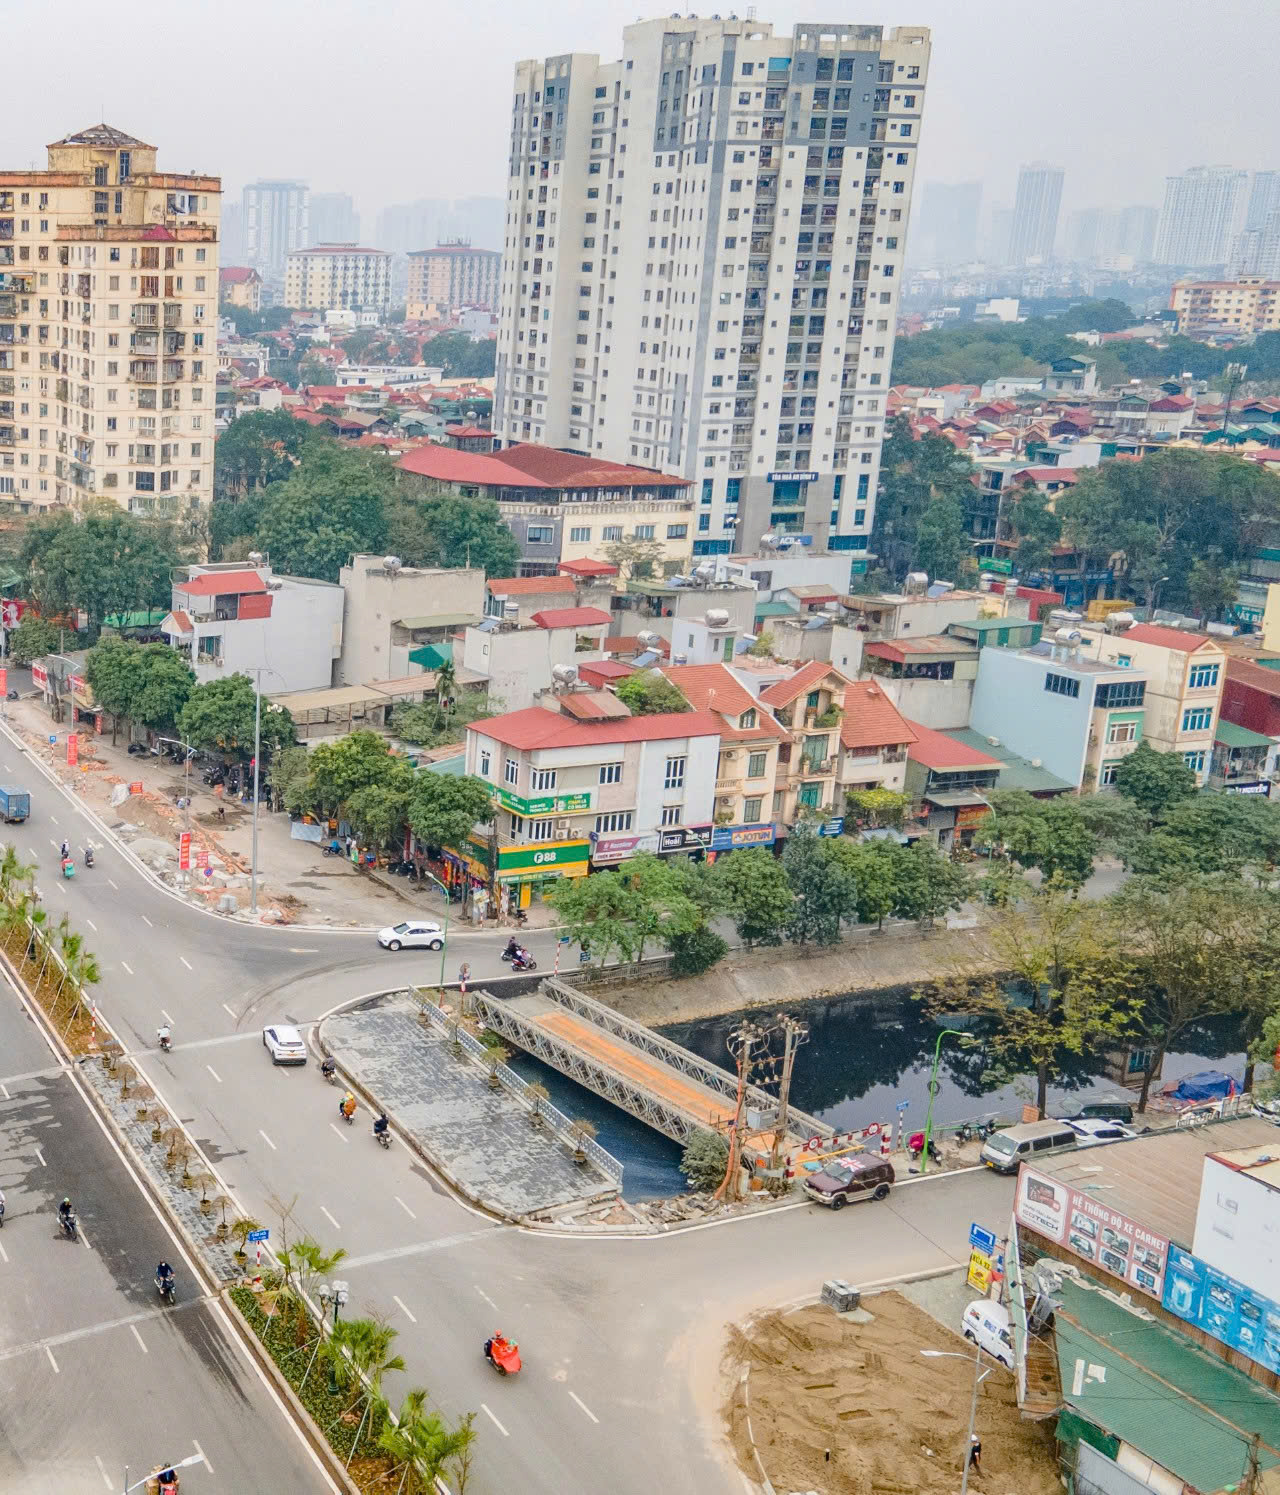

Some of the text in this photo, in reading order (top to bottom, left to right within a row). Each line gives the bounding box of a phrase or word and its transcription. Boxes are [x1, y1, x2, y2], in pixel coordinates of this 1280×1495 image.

[741, 831, 770, 844] JOTUN
[534, 851, 556, 864] F88
[1072, 1195, 1084, 1211] HỆ
[1084, 1203, 1110, 1221] THỐNG
[1110, 1214, 1122, 1231] ĐỘ
[1123, 1221, 1135, 1235] XE
